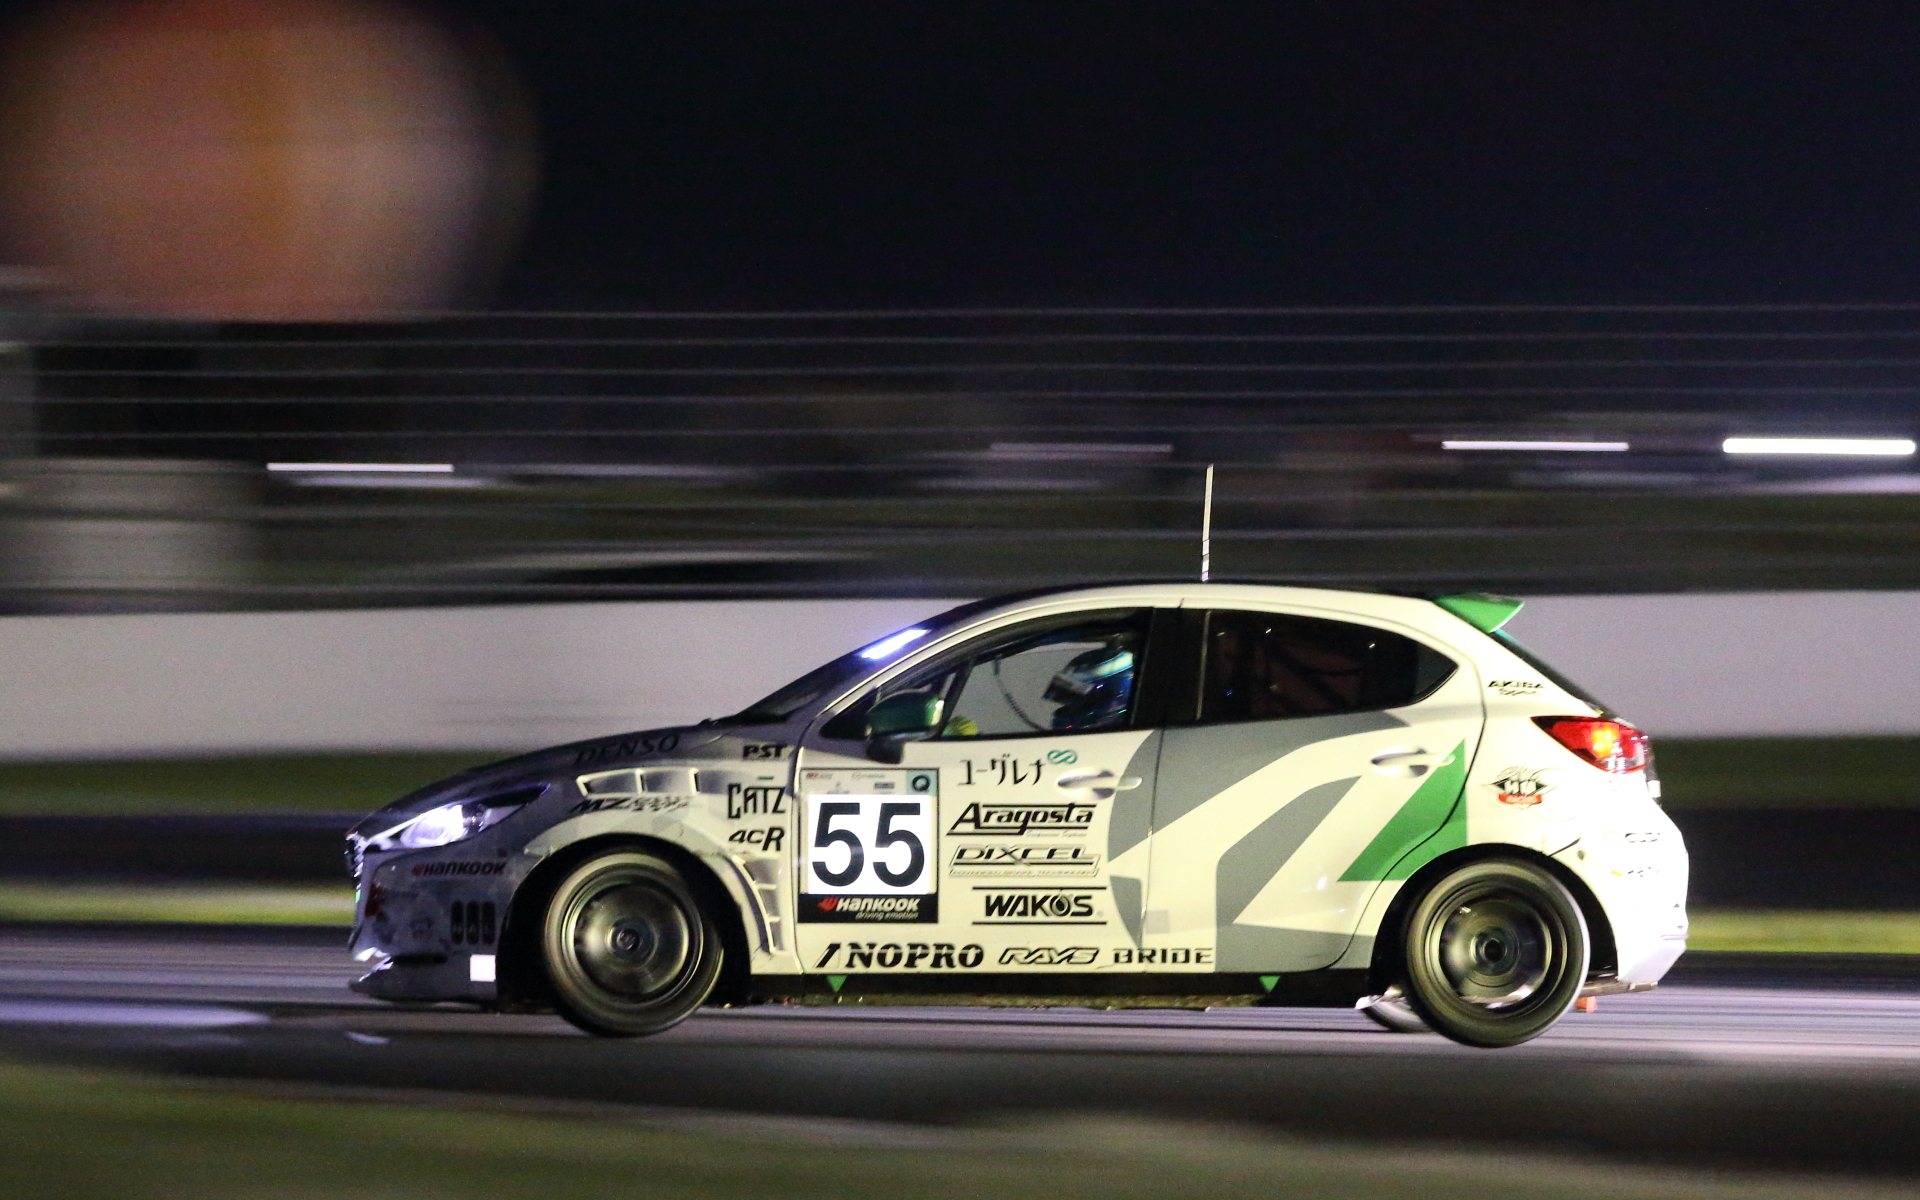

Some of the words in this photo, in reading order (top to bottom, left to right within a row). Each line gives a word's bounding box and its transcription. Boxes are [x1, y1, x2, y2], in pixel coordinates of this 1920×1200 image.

[576, 734, 680, 764] DENSO
[743, 745, 788, 758] PST
[957, 753, 1046, 786] ユーグレナ
[728, 782, 787, 819] CATZ
[946, 801, 1096, 836] Aragosta
[812, 803, 925, 887] 55
[955, 848, 1095, 864] DIXCEL
[855, 911, 884, 921] driving
[884, 911, 919, 920] emotion
[999, 947, 1100, 964] RAYS
[1112, 947, 1213, 964] BRIDE
